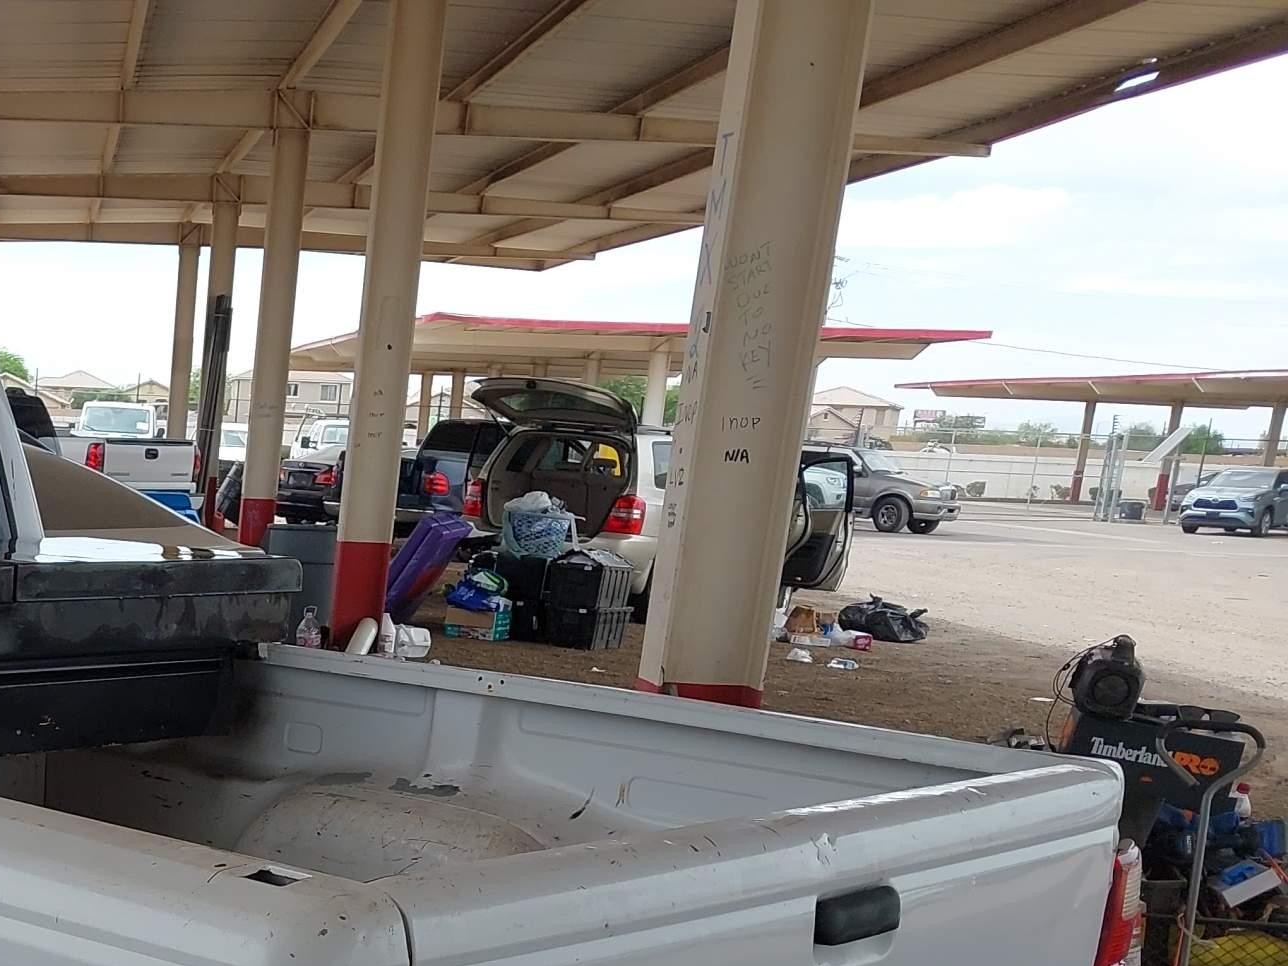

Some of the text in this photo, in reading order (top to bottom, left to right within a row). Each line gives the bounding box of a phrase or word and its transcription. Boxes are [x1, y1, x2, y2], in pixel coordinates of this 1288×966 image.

[727, 258, 773, 290] START
[724, 448, 750, 464] N/A
[1172, 751, 1220, 776] PRO
